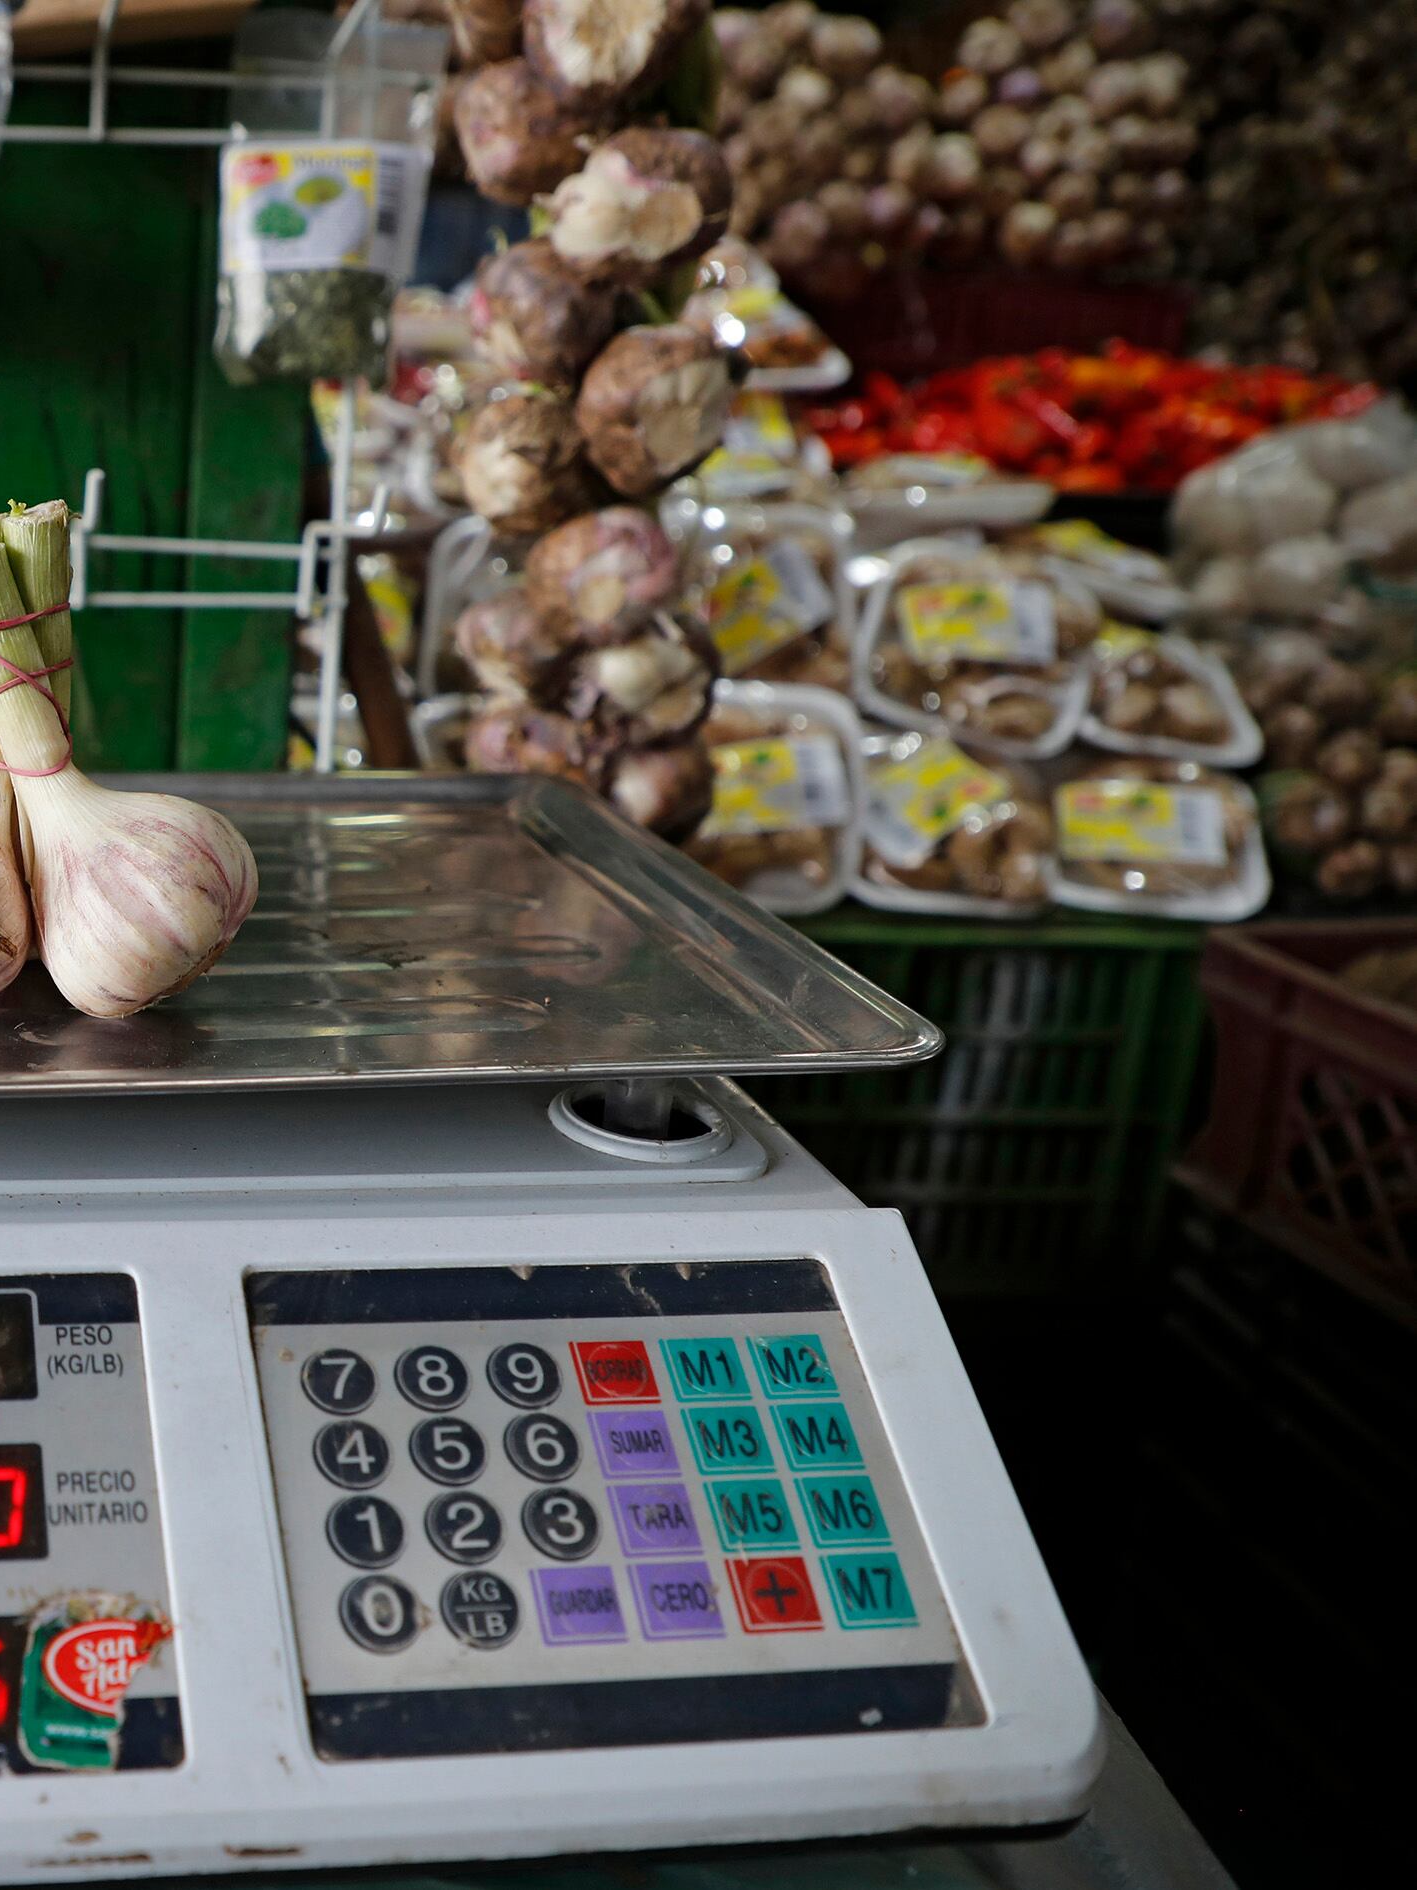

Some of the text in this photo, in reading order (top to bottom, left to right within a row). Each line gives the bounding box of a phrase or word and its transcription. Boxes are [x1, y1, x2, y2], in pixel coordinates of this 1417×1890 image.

[56, 1325, 113, 1346] PESO
[47, 1353, 124, 1378] (KG/LB)
[320, 1358, 357, 1400] 7
[416, 1355, 455, 1397] 8
[507, 1352, 545, 1394] 9
[678, 1350, 735, 1388] M1
[763, 1347, 826, 1385] M2
[337, 1429, 376, 1474] 4
[432, 1426, 471, 1470] 5
[525, 1423, 565, 1467] 6
[610, 1428, 665, 1454] SUMAR
[697, 1419, 759, 1458] M3
[787, 1416, 848, 1456] M4
[57, 1469, 136, 1494] PRECIO
[48, 1501, 148, 1526] UNITARIO
[356, 1505, 383, 1552] 1
[447, 1501, 490, 1549] 2
[543, 1498, 585, 1545] 3
[629, 1504, 688, 1530] TARA
[719, 1492, 782, 1535] M5
[812, 1489, 875, 1531] M6
[462, 1577, 501, 1601] KG
[650, 1583, 710, 1613] CERO
[836, 1567, 893, 1611] M7
[360, 1584, 405, 1637] 0
[467, 1612, 508, 1638] LB
